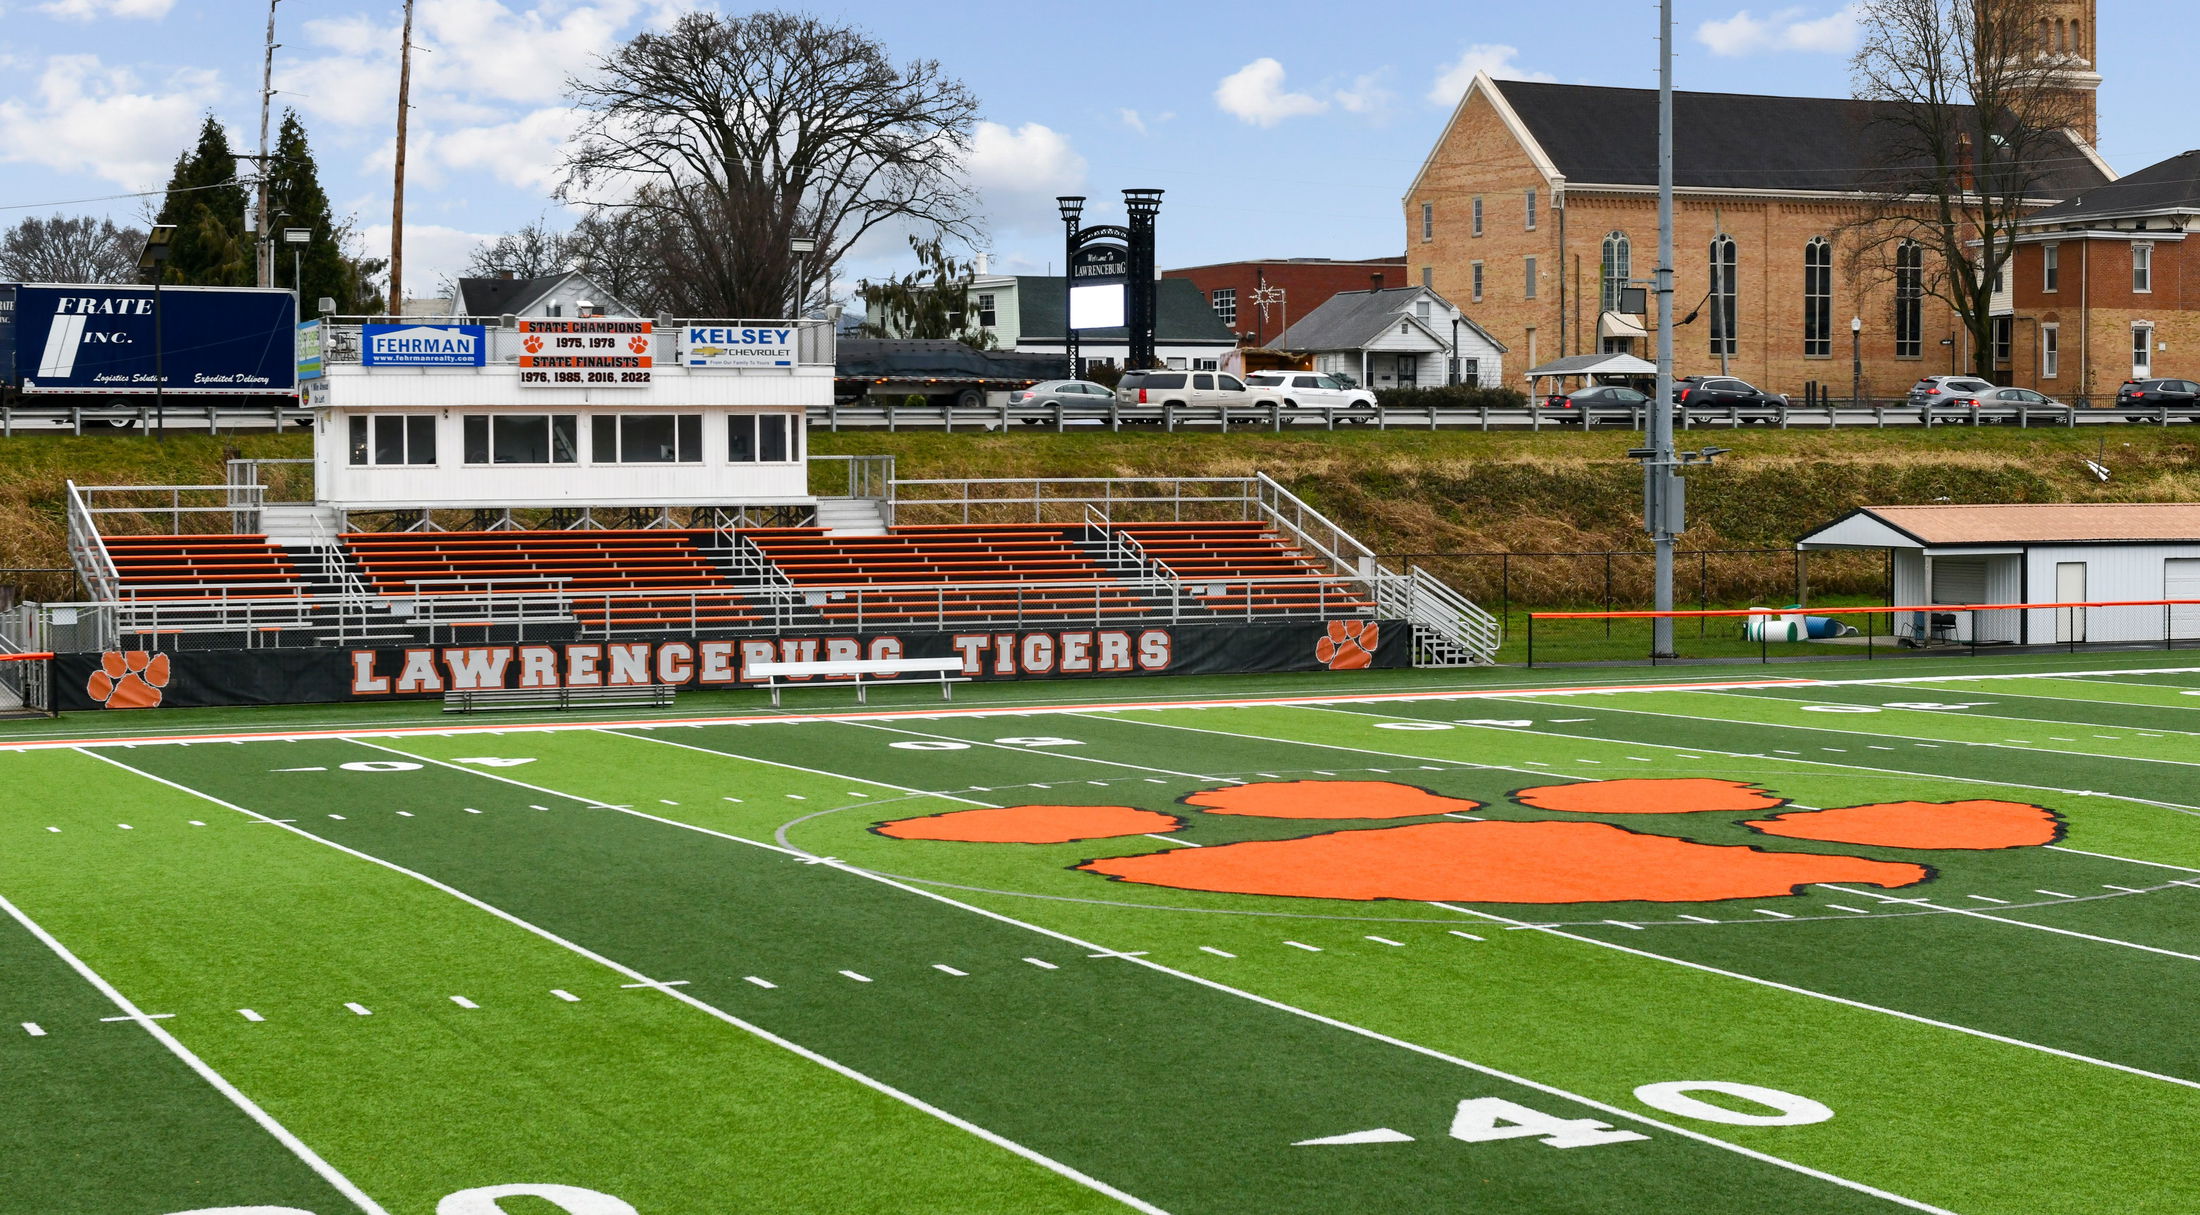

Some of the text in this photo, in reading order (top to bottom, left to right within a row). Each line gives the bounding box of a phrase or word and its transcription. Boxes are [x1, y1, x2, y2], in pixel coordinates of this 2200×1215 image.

[1074, 261, 1126, 277] LAWRENCEBURG
[55, 297, 154, 315] FRATE
[528, 322, 642, 333] STATE CHAMPIONS
[83, 332, 133, 344] INC.
[690, 328, 791, 345] KELSEY
[377, 338, 470, 353] FEHRMAN
[556, 337, 615, 349] 1975, 1978
[728, 348, 791, 356] CHEVROLET
[373, 355, 475, 363] www.fehrmanrealty.com
[532, 356, 639, 367] STATE FINALISTS
[92, 372, 270, 385] Logistics Solutins Expedited Delivery
[521, 372, 651, 383] 1976, 1985, 2016, 2022
[351, 629, 1171, 695] LAWRENCEBURG TIGERS
[1449, 1080, 1836, 1149] 40
